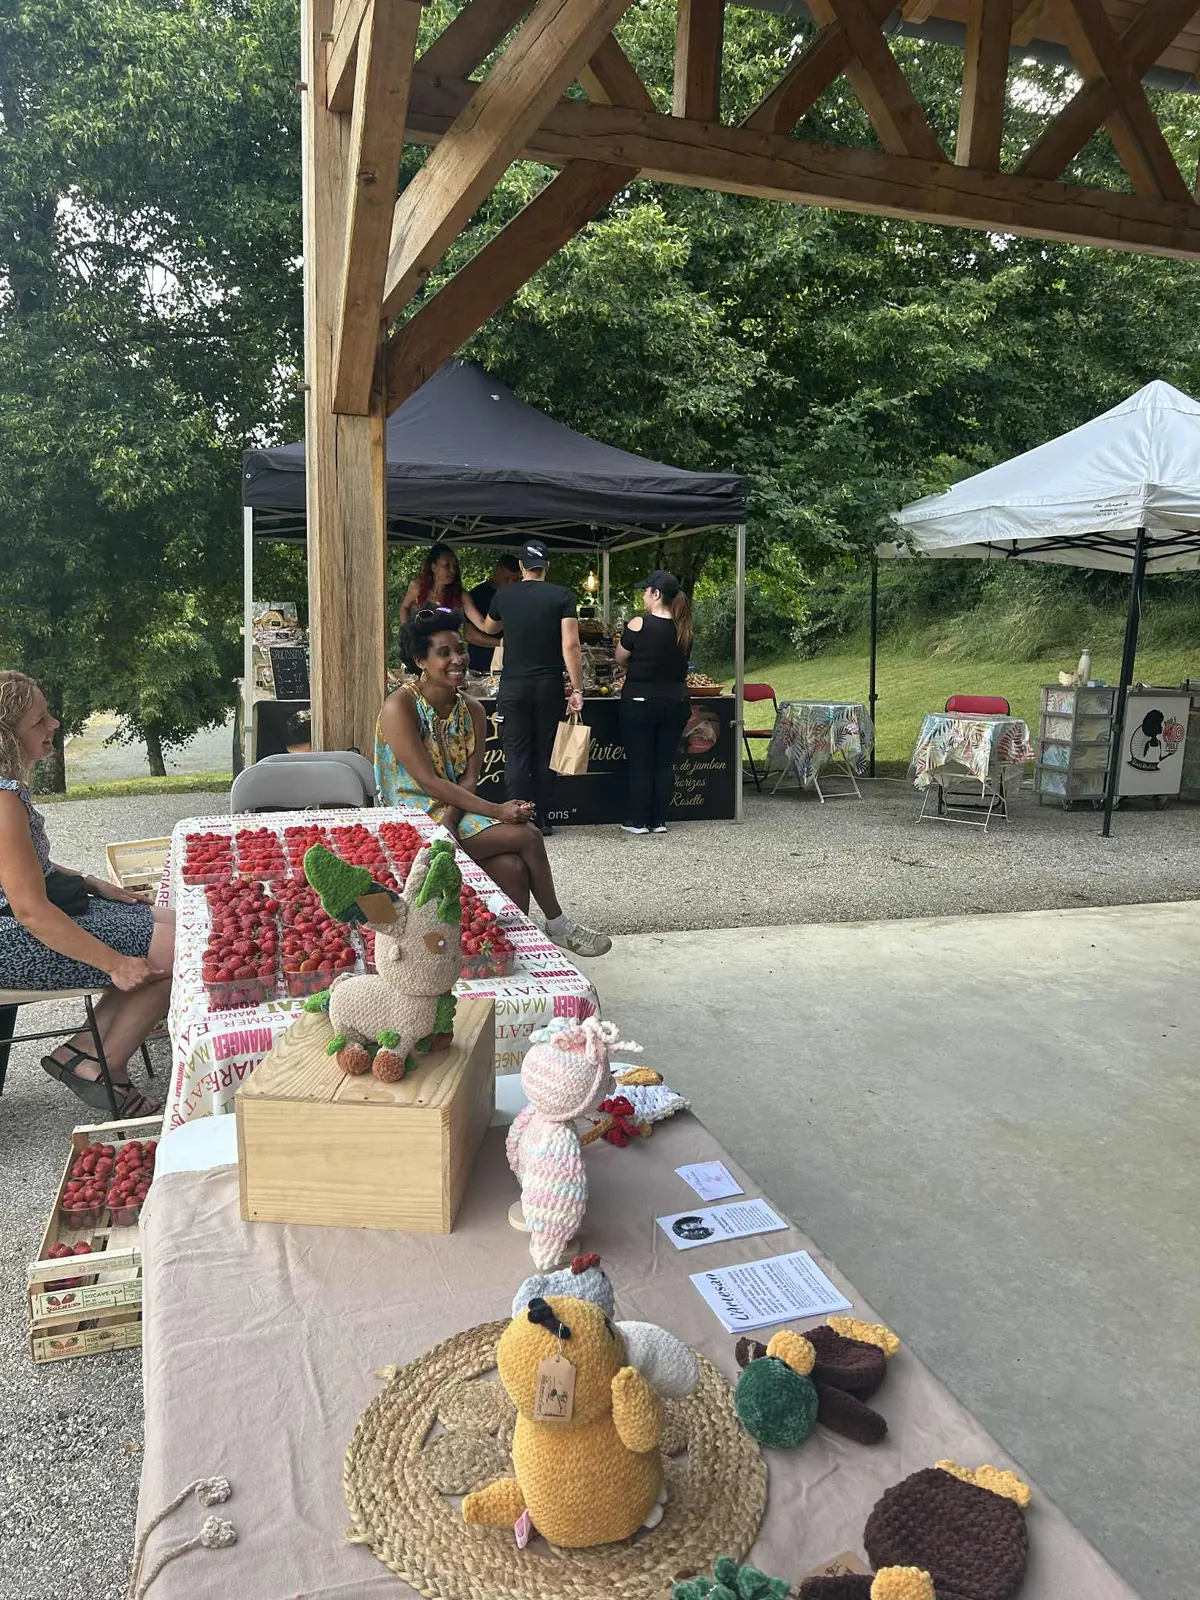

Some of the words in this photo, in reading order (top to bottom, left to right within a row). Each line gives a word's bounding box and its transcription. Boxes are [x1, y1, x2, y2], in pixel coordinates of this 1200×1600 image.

[530, 969, 578, 978] COMER
[502, 985, 550, 998] EAT
[201, 1008, 257, 1022] MANGER
[223, 1014, 285, 1028] COMER
[495, 1022, 536, 1040] EAT
[211, 1027, 273, 1062] MANGER
